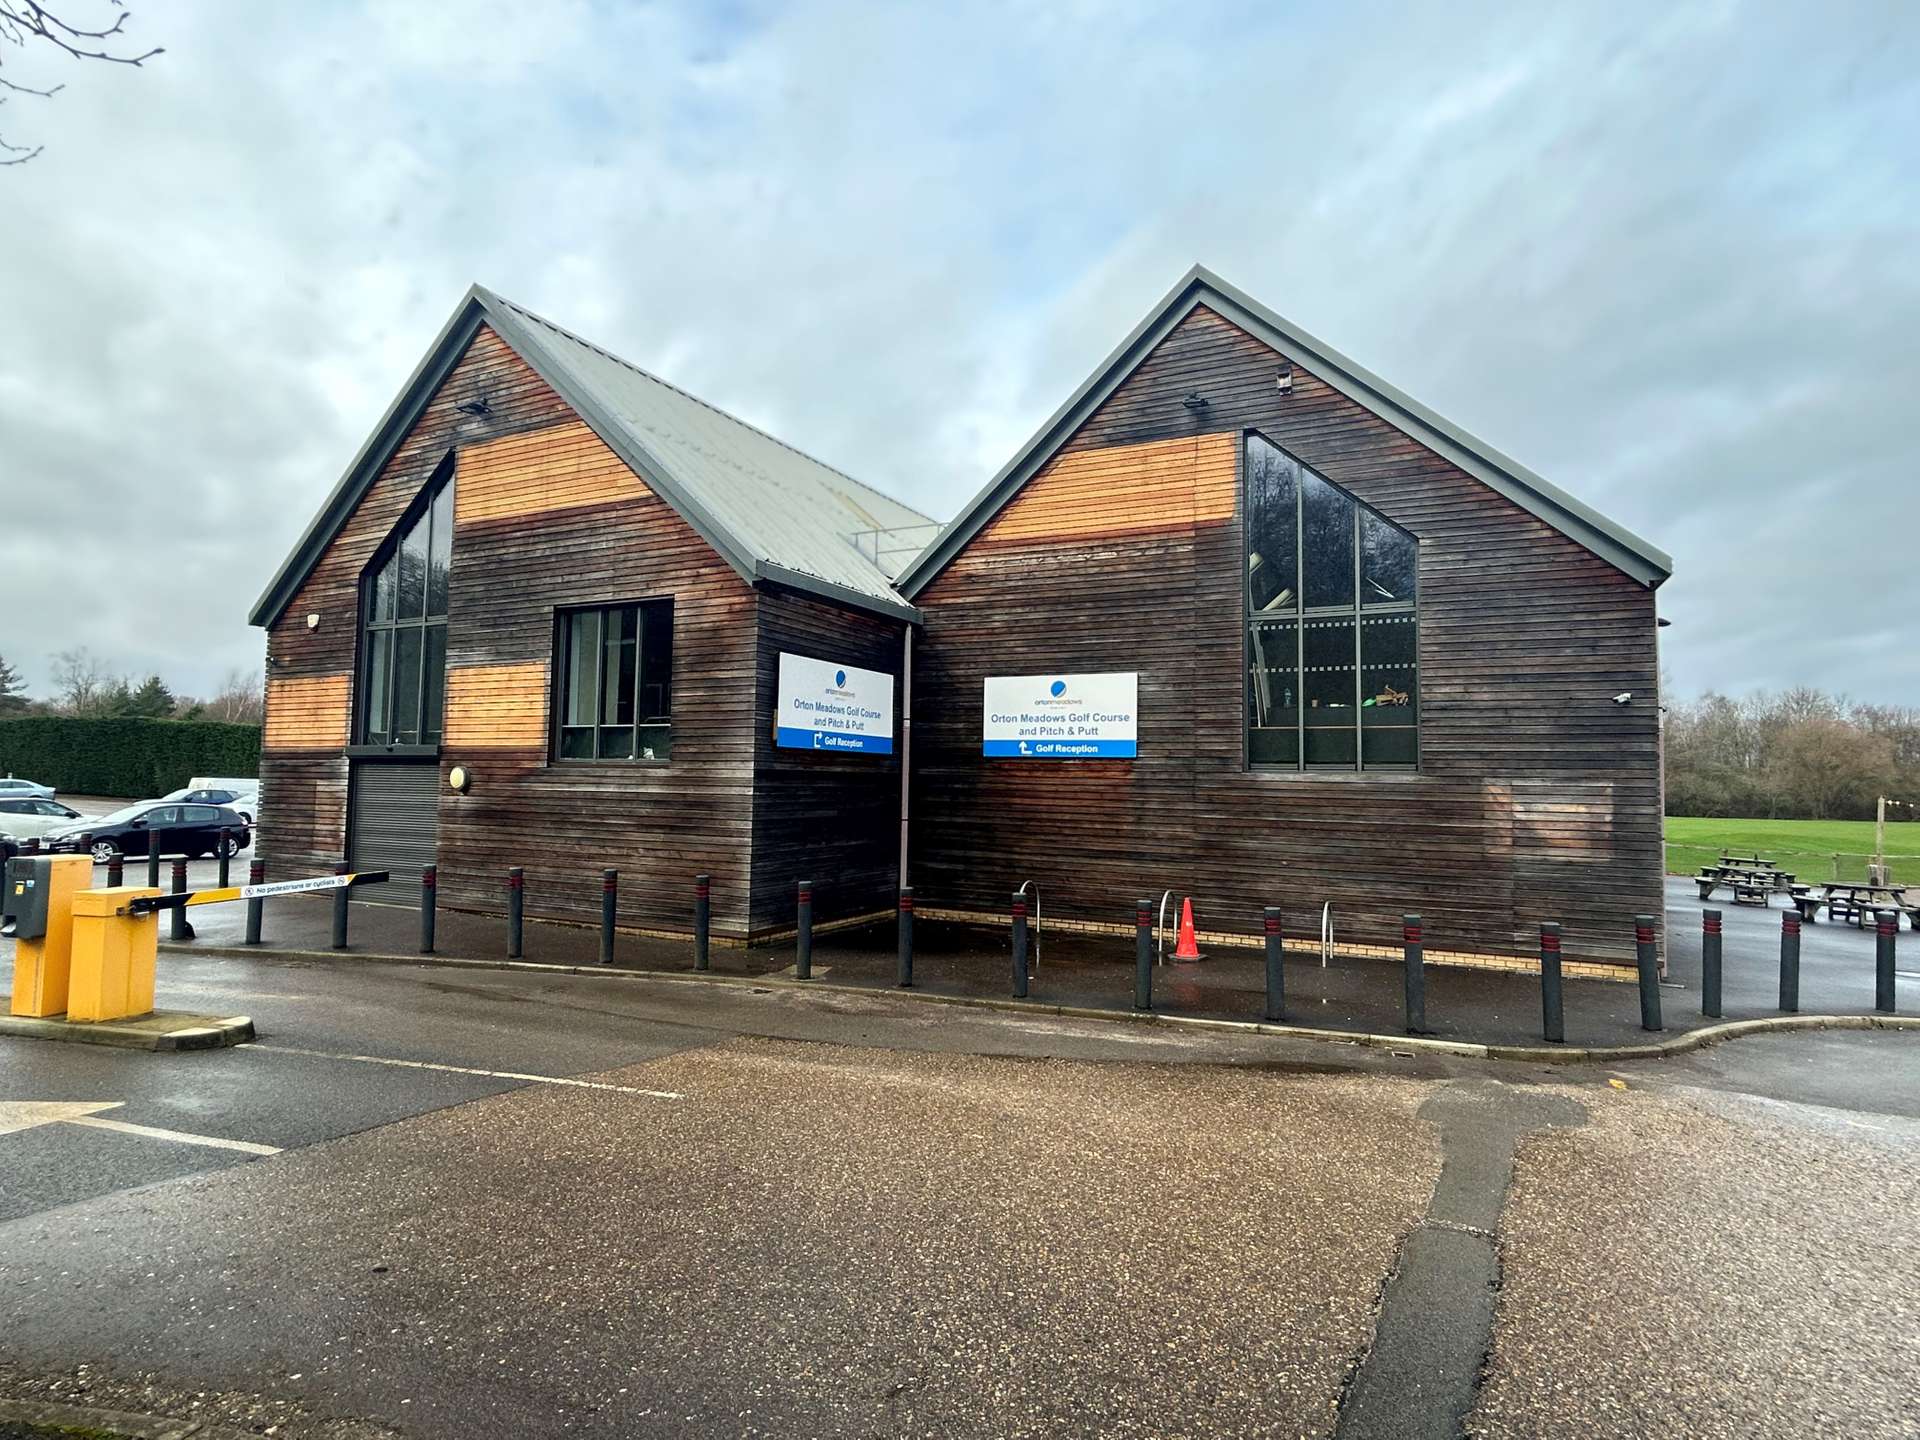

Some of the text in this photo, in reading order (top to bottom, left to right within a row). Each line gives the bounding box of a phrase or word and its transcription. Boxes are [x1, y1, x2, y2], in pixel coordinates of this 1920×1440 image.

[794, 698, 881, 719] Orton Meadows Golf Course
[814, 717, 864, 730] and Pitch & Putt
[991, 713, 1130, 723] Orton Meadows Golf Course
[1018, 727, 1099, 736] and Pitch & Putt
[825, 736, 863, 749] Golf Reception
[1035, 744, 1098, 755] Golf Reception
[266, 883, 304, 894] pedestrians
[313, 879, 335, 888] cyclists
